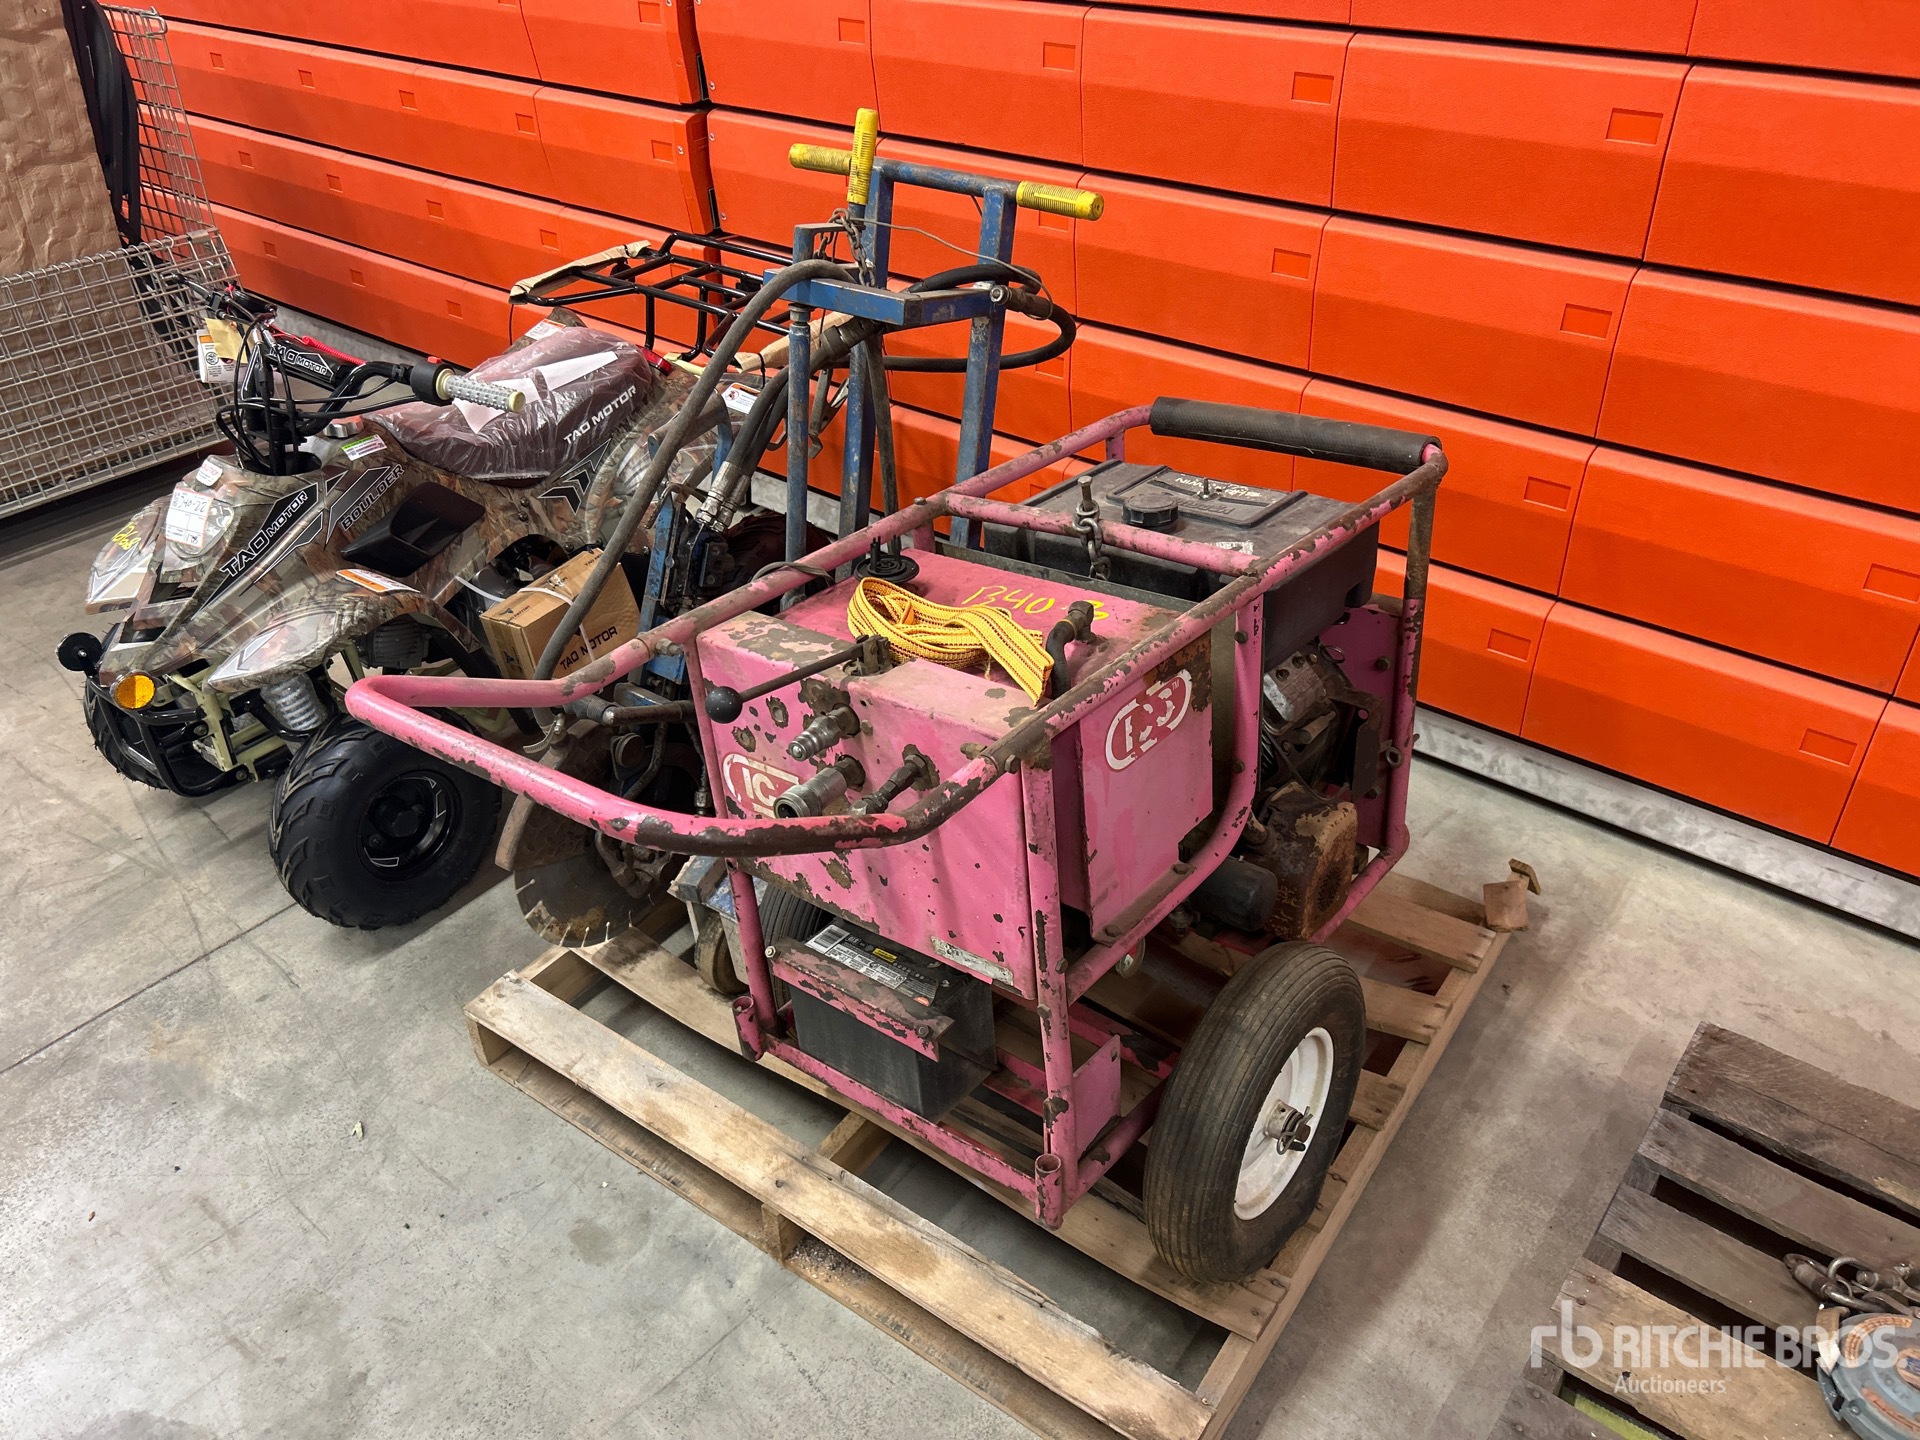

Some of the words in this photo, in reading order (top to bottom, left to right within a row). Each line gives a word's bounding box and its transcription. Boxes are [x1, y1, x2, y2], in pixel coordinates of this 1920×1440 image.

[297, 358, 328, 375] MOTOR
[564, 421, 592, 445] TAO
[592, 385, 637, 426] MOTOR
[341, 464, 405, 532] BOULDER
[220, 529, 271, 577] TAO
[266, 490, 309, 538] MOTOR
[560, 651, 580, 670] TAO
